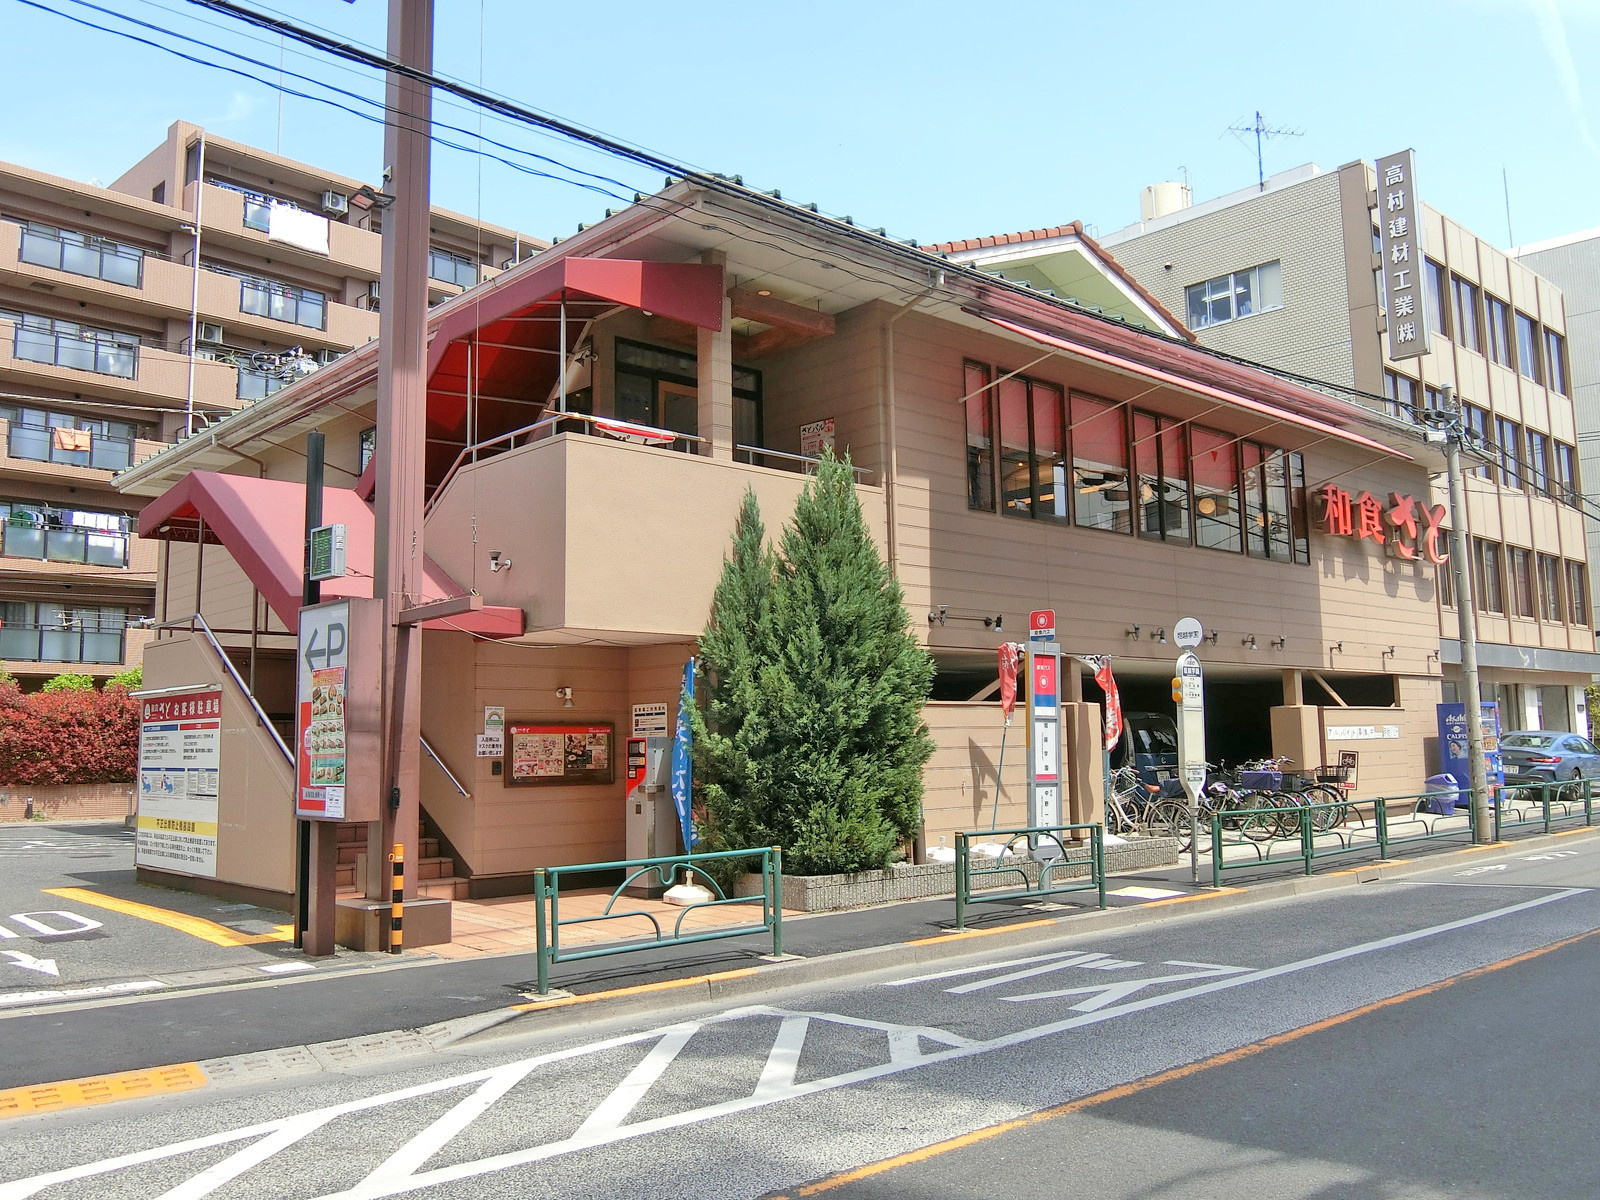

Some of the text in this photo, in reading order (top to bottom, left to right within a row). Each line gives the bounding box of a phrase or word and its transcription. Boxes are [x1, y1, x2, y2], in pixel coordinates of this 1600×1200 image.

[1317, 482, 1450, 565] 和食さと
[326, 622, 346, 668] P
[174, 698, 219, 717] お客様駐車場
